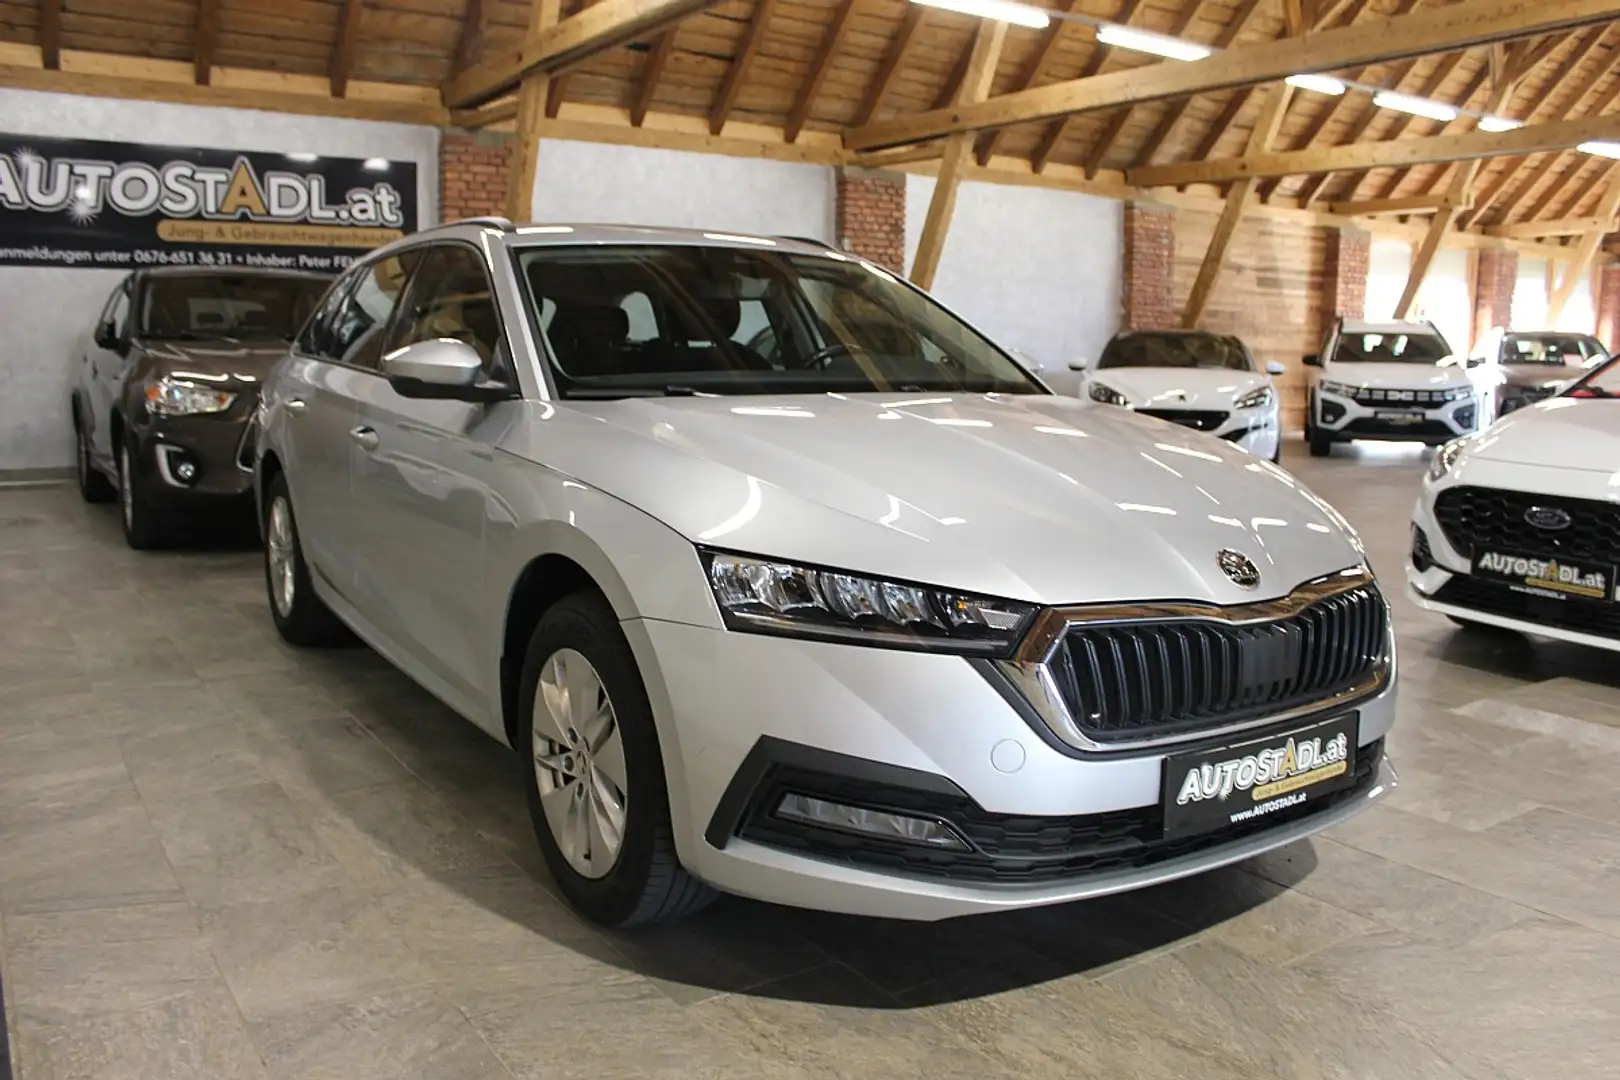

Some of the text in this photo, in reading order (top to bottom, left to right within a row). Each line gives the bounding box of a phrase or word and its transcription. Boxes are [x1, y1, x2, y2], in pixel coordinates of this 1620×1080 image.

[0, 154, 402, 224] AUTOSTADL.at
[168, 223, 211, 241] Jung-
[216, 226, 226, 236] &
[95, 250, 130, 262] unter
[217, 252, 232, 265] 31
[299, 254, 330, 268] Peter
[1478, 552, 1605, 588] AUTOSTADL.at
[1177, 733, 1347, 804] AUTOSTADL.at
[1230, 792, 1307, 823] www.AUTOSTADL.at
